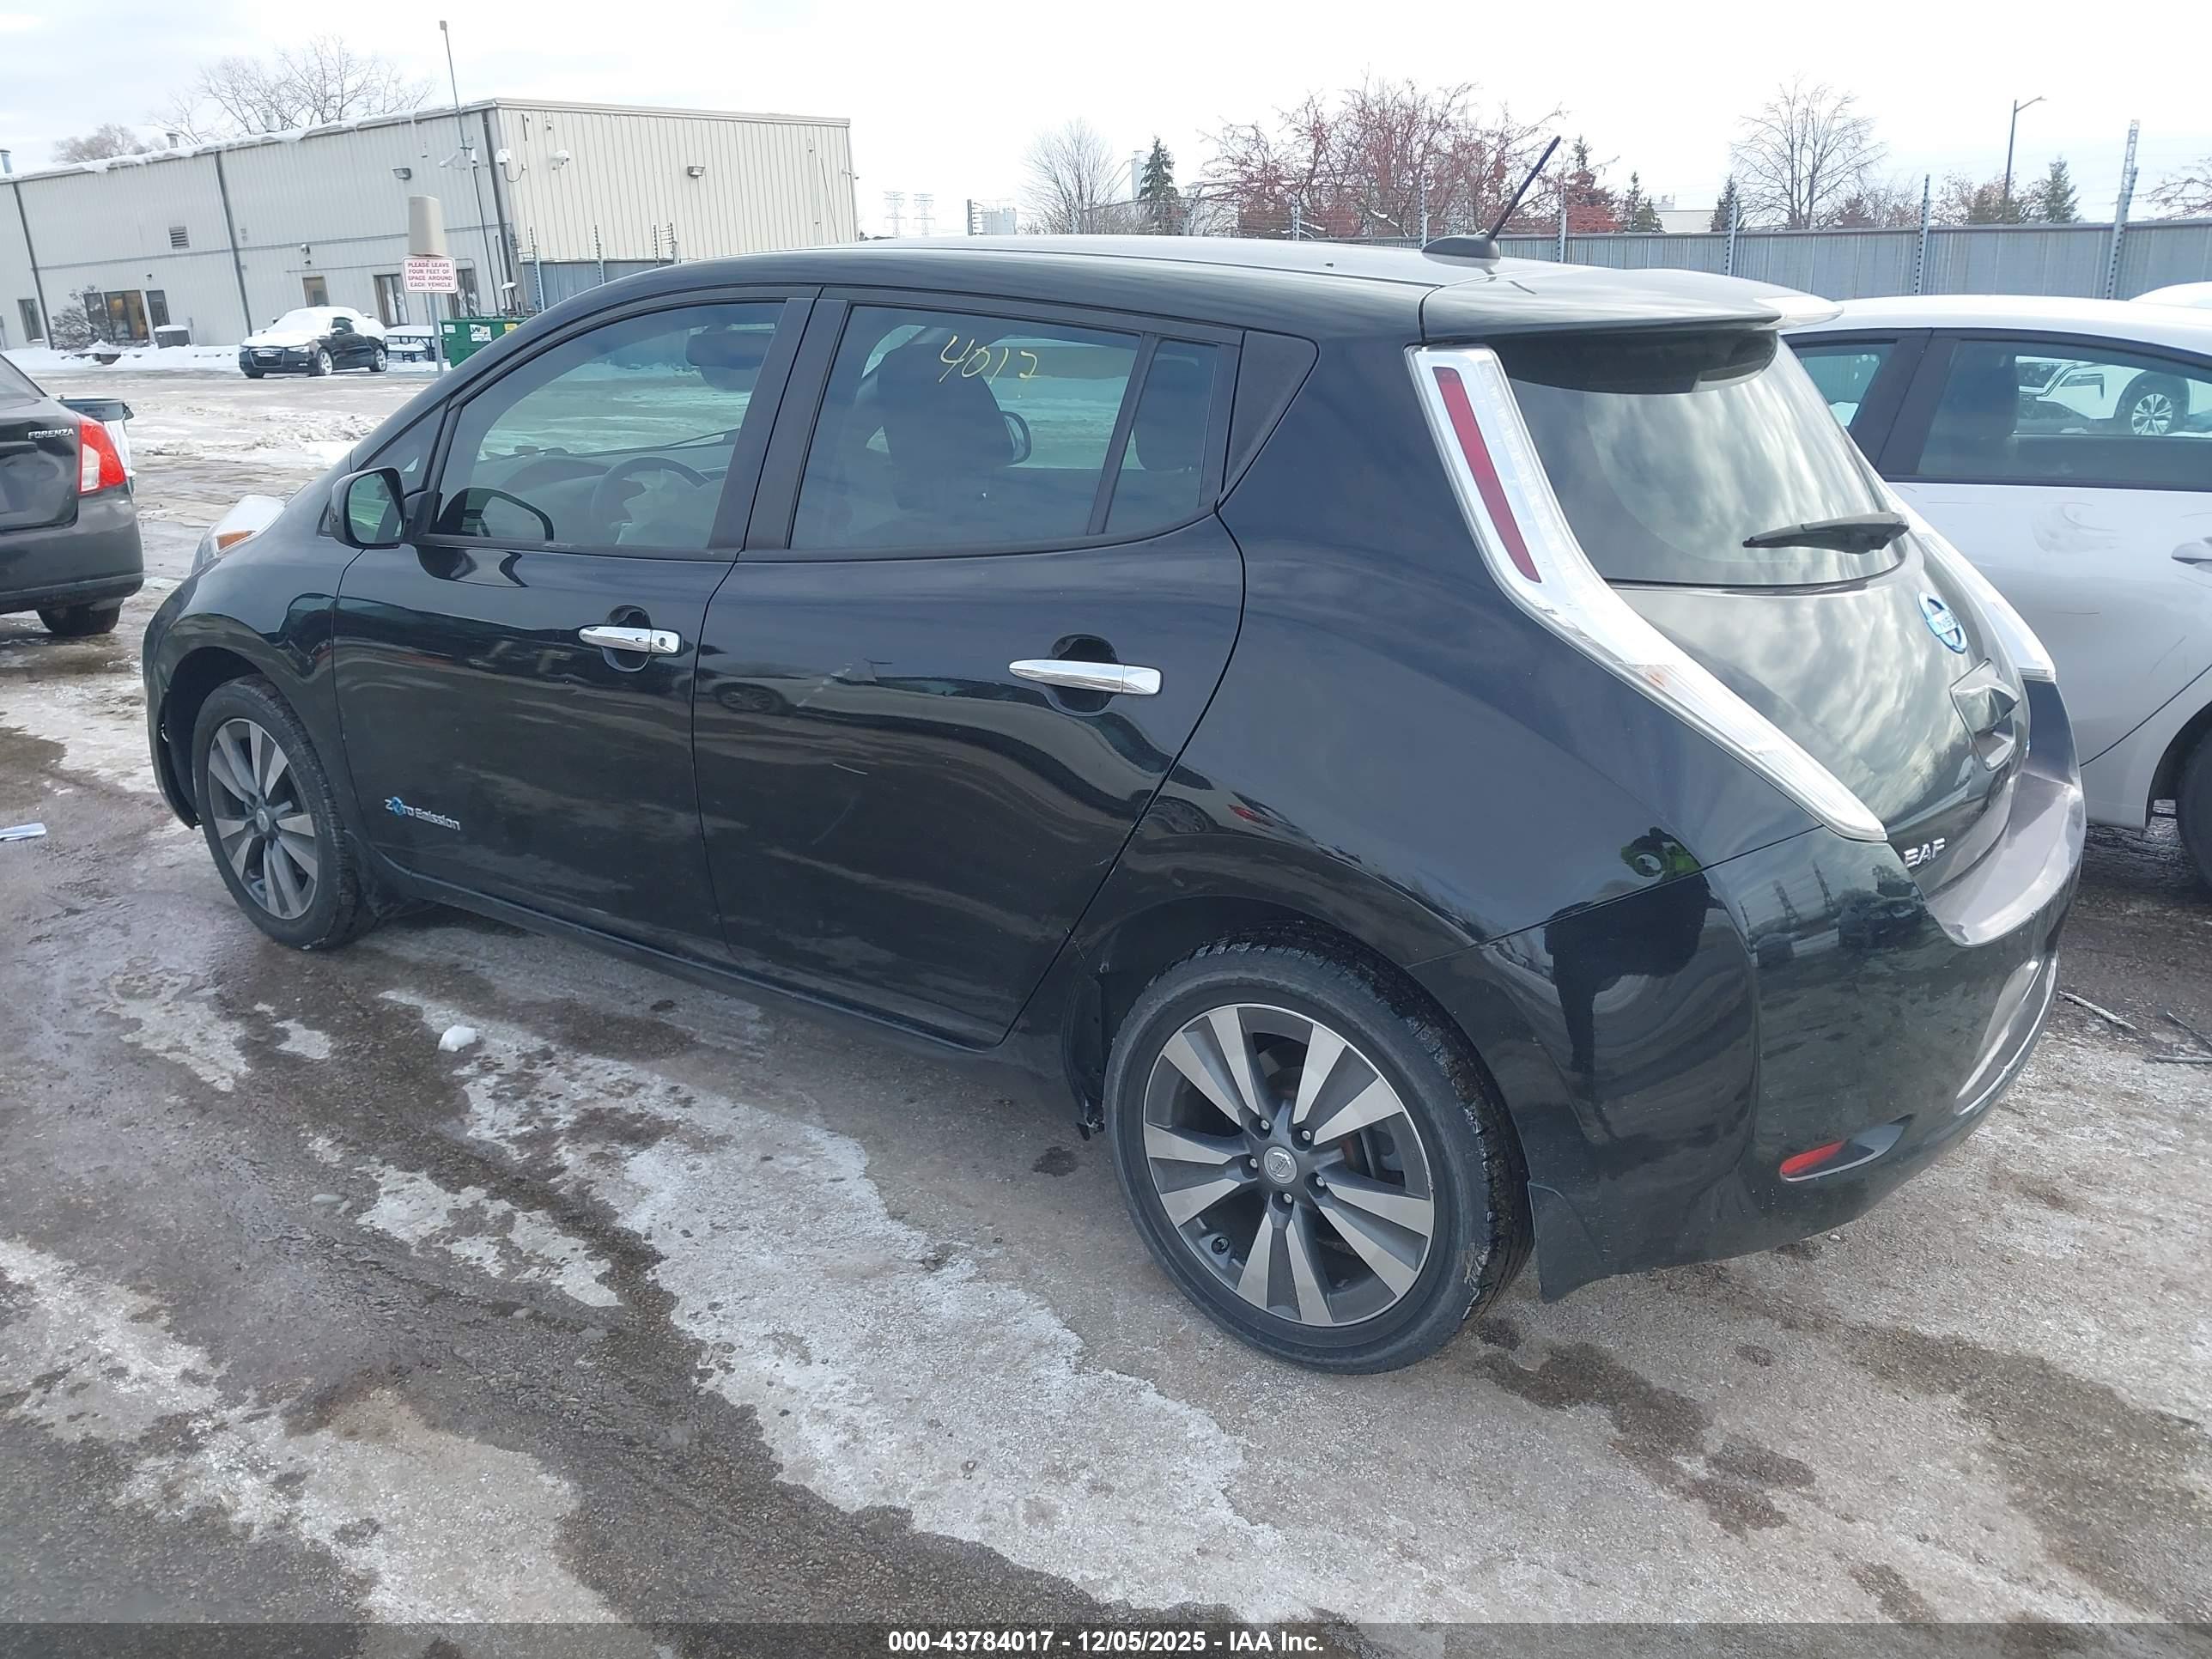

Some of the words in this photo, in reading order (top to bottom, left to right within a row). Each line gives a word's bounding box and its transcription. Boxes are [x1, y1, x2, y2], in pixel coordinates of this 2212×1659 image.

[27, 428, 74, 440] FORENZA
[415, 807, 461, 831] Emission
[1903, 837, 1946, 867] EAF
